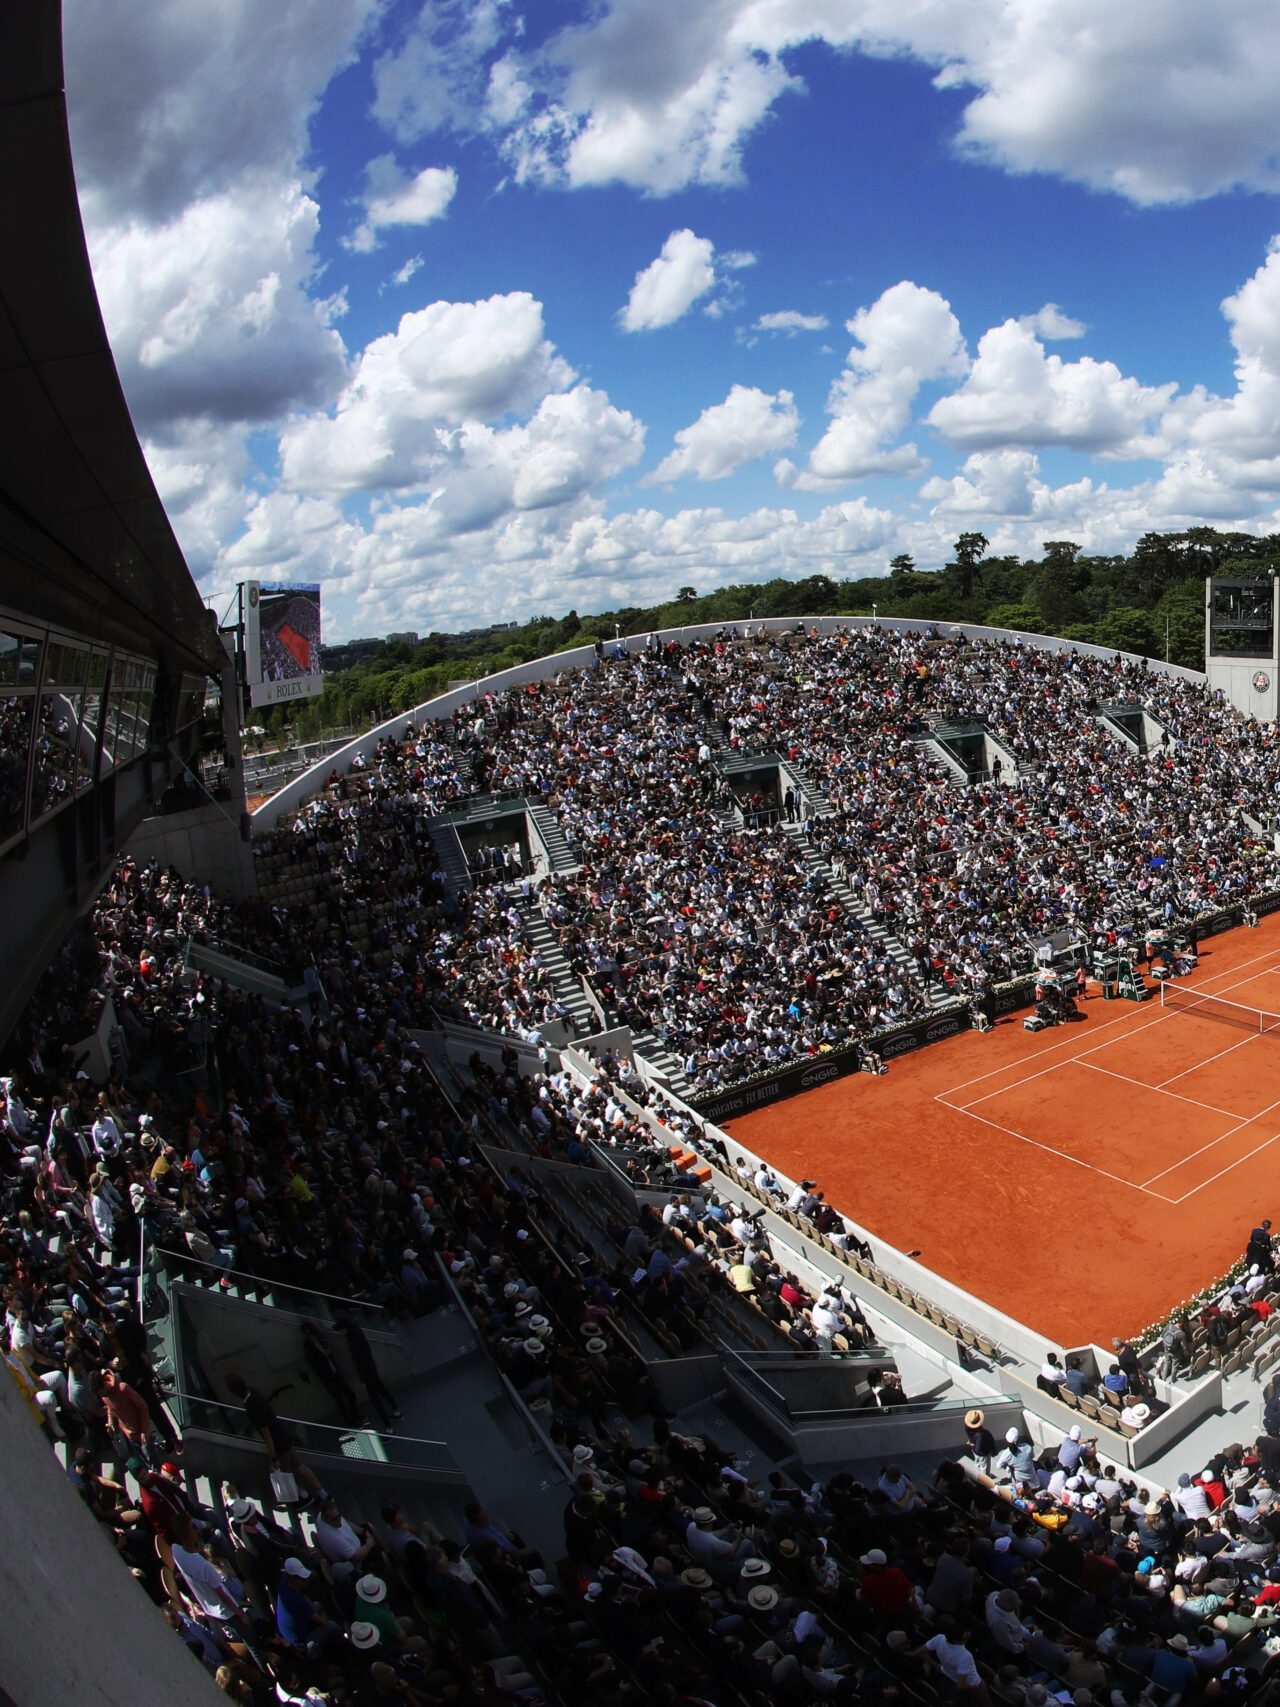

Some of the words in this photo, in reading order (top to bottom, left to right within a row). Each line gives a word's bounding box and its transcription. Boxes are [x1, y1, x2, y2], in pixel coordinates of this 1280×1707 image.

[276, 682, 303, 698] ROLEX
[746, 1090, 756, 1104] FLY
[757, 1082, 780, 1100] BETTER
